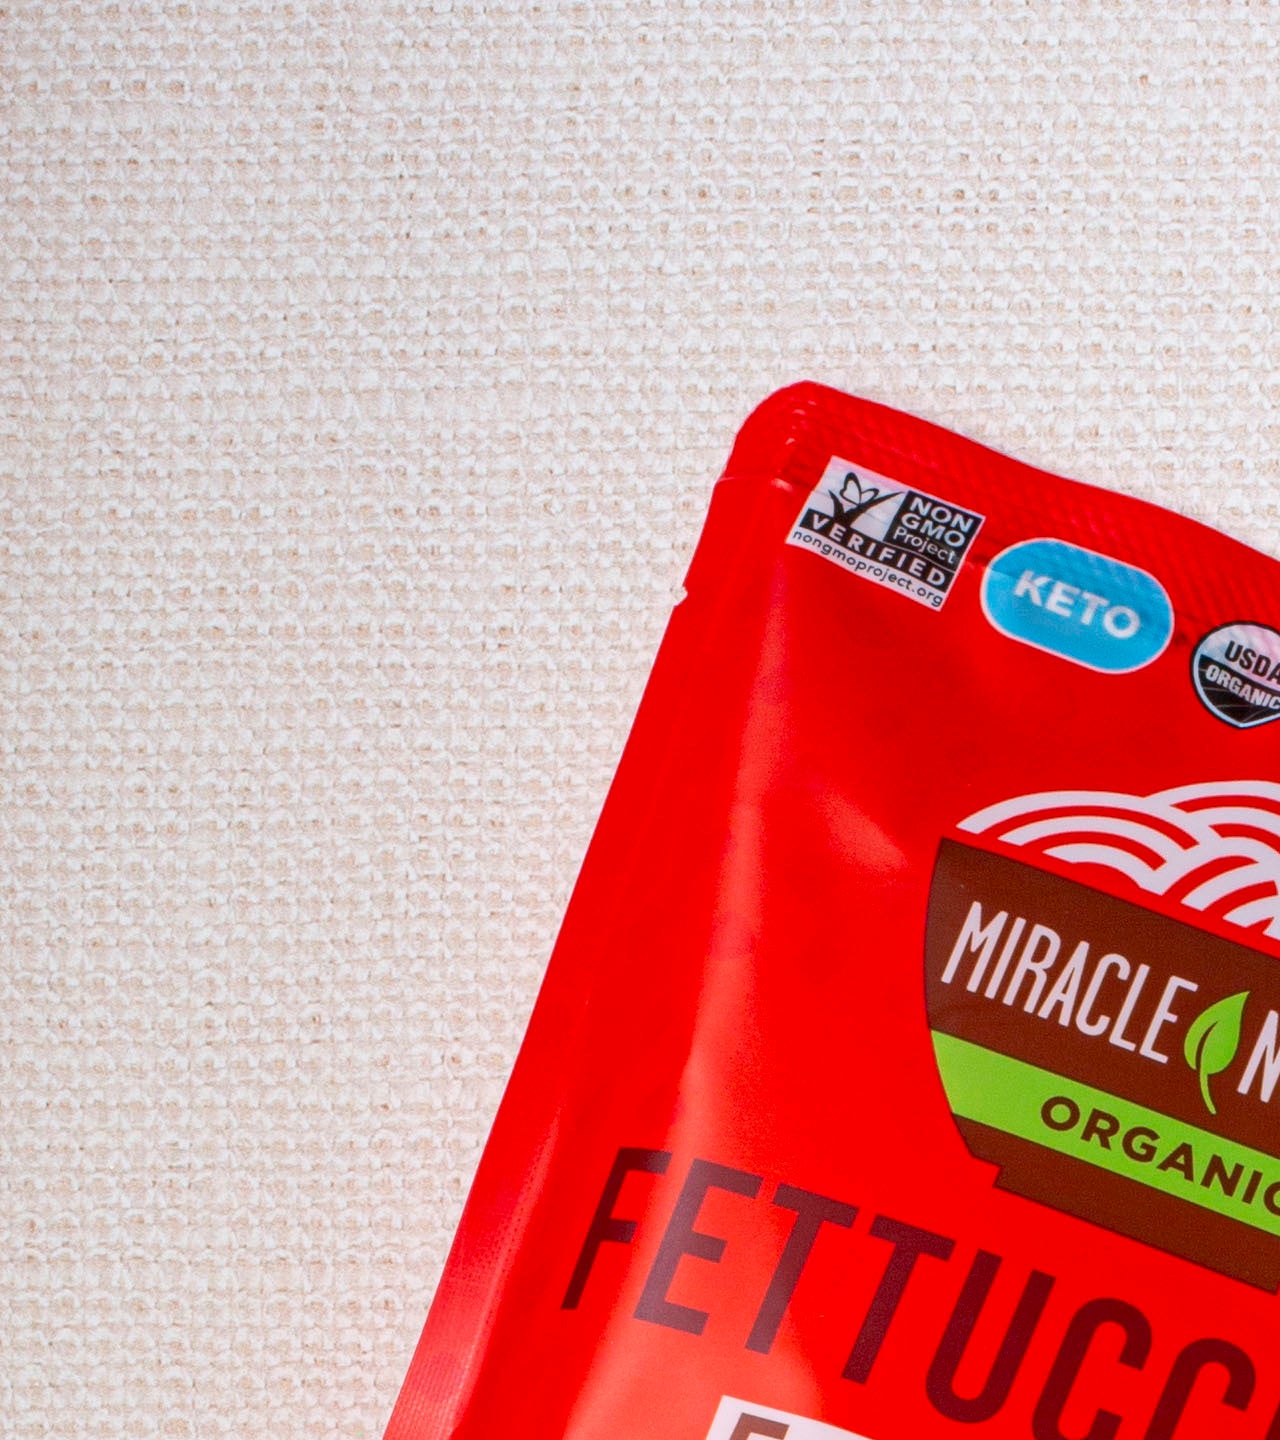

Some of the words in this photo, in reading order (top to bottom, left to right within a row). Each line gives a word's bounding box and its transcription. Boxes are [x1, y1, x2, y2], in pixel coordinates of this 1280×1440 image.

[811, 513, 946, 587] VERIFIED
[893, 526, 956, 565] Project
[901, 512, 966, 548] GMO
[910, 497, 974, 533] NON
[792, 530, 944, 608] nongmoproject.org
[1013, 568, 1142, 641] KETO
[941, 900, 1198, 1064] MIRACLE
